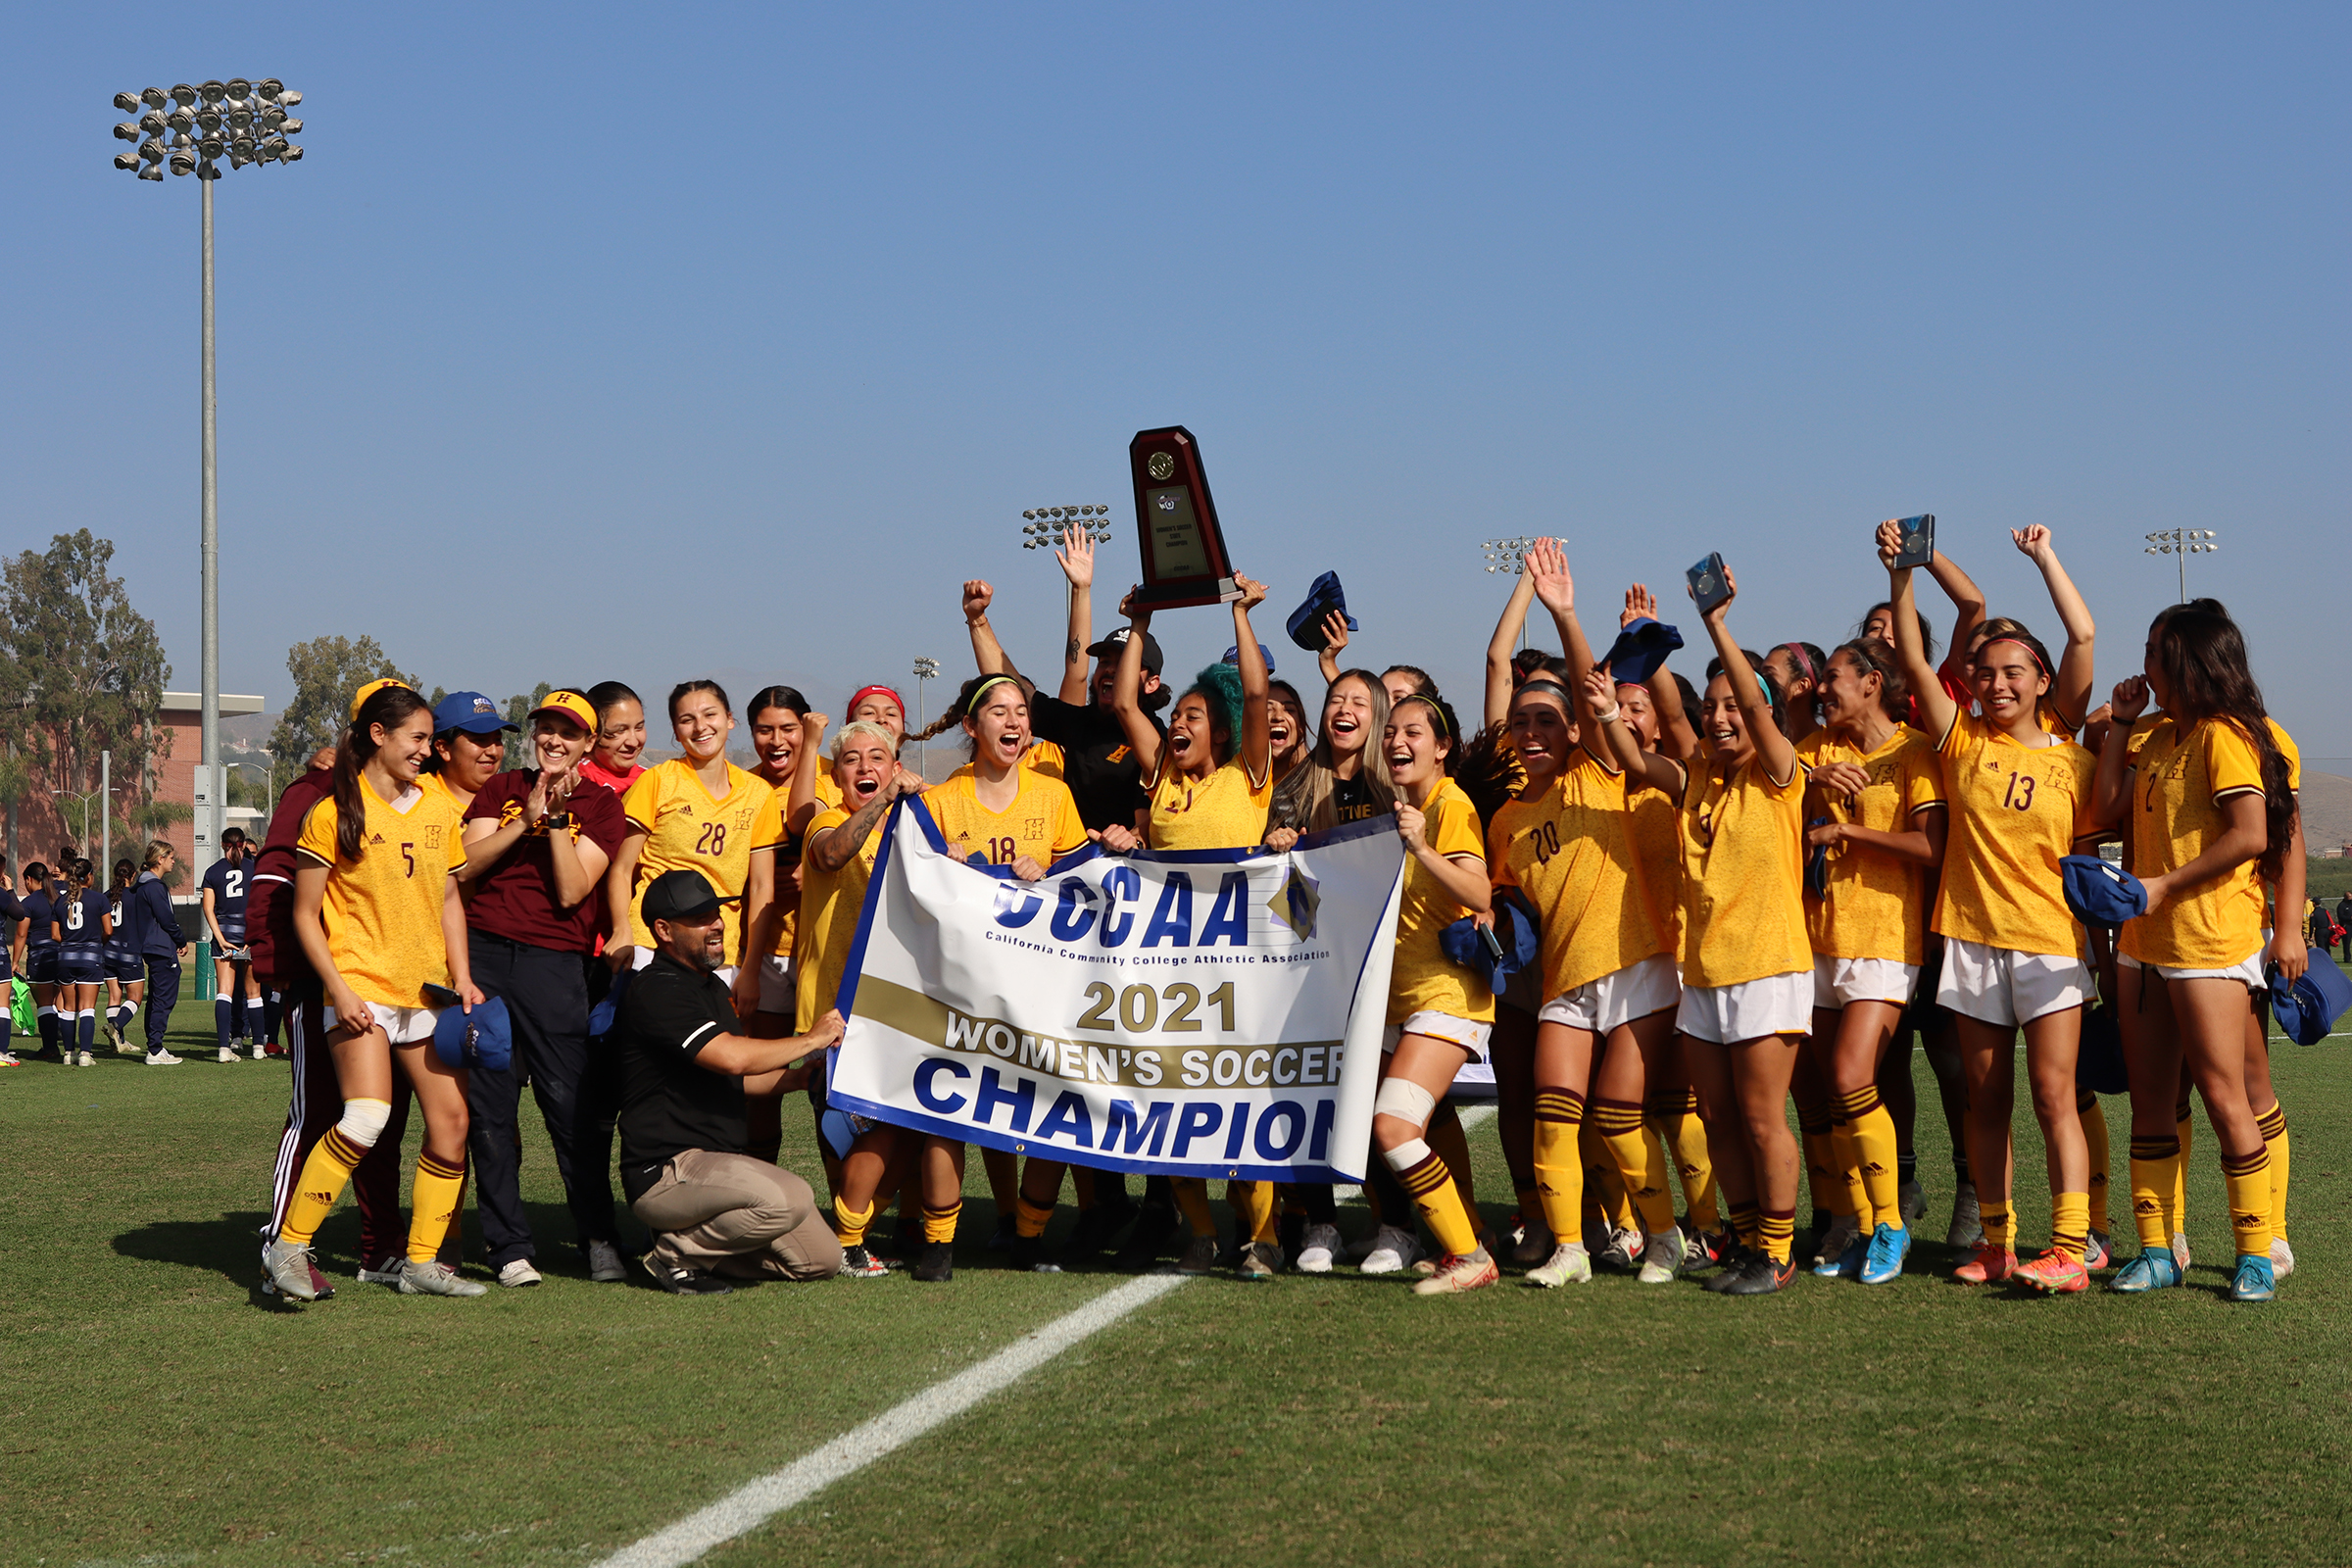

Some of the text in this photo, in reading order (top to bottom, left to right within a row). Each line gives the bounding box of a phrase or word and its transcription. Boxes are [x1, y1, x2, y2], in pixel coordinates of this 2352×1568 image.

[556, 693, 572, 704] H
[2003, 771, 2035, 811] 13
[2145, 772, 2157, 812] 2
[425, 825, 441, 849] H
[732, 808, 754, 831] H
[1024, 818, 1044, 841] H
[695, 821, 726, 857] 28
[988, 836, 1016, 865] 18
[1530, 819, 1560, 866] 20
[401, 842, 414, 879] 5
[225, 869, 243, 898] 2
[111, 900, 122, 927] 9
[986, 931, 1330, 966] California Community College Athletic Association
[1076, 981, 1235, 1033] 2021
[944, 1010, 1163, 1087] WOMEN'S
